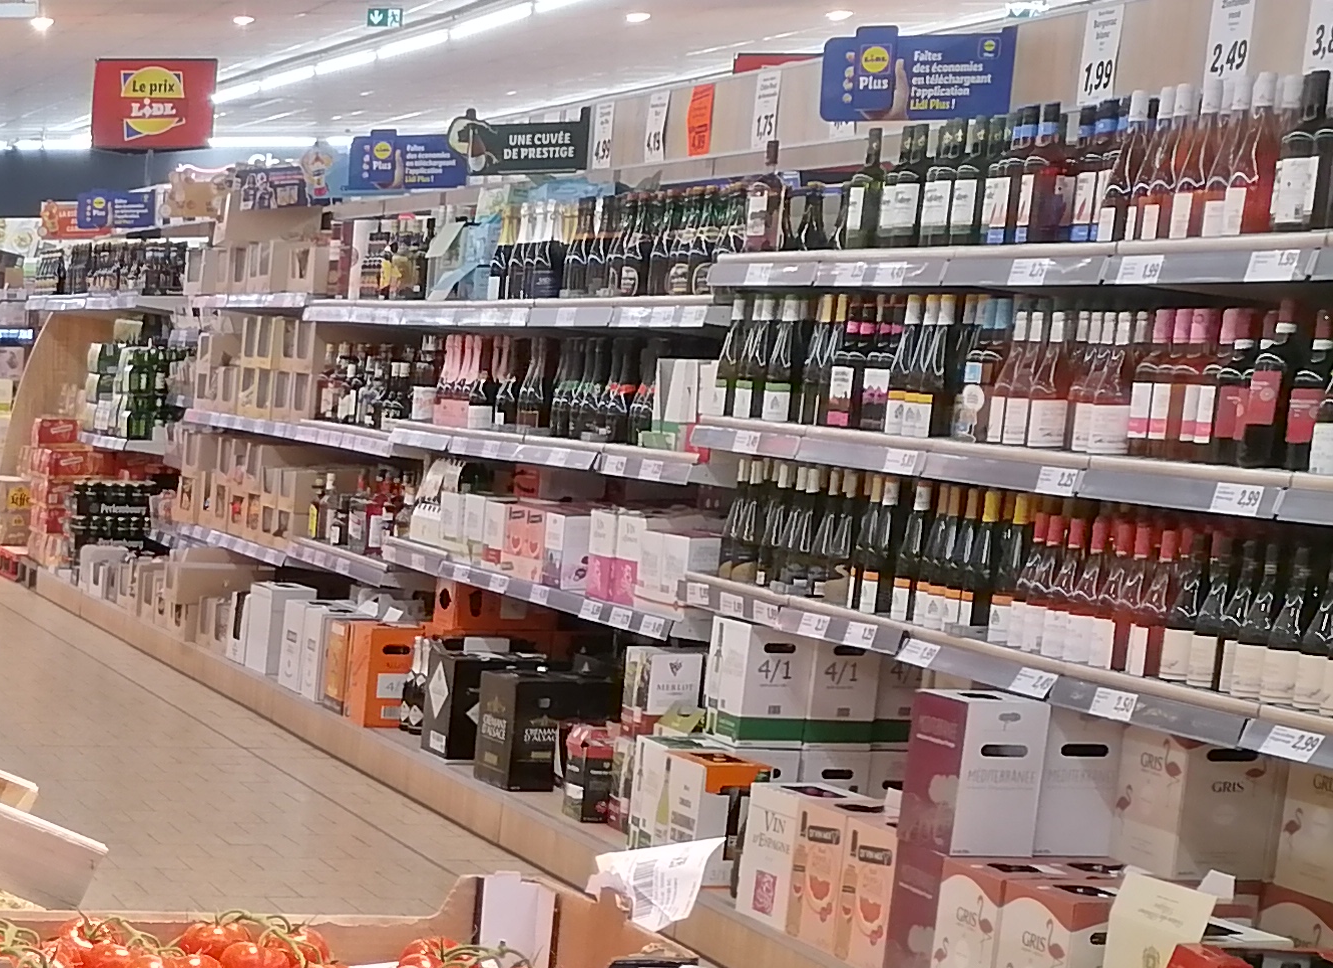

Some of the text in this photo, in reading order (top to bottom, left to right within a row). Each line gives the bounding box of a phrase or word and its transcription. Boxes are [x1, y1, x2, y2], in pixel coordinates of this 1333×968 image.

[914, 50, 942, 62] Faites
[1210, 39, 1247, 76] 2,49
[912, 60, 983, 74] des économies
[859, 76, 889, 90] Plus
[911, 73, 992, 87] en téléchargeant
[1084, 59, 1113, 96] 1,99
[132, 80, 175, 96] Le prix
[910, 99, 928, 110] Lidl
[931, 98, 950, 110] Plus
[508, 132, 571, 146] UNE CUVÉE
[503, 146, 575, 160] DE PRESTIGE
[372, 160, 392, 171] Plus
[1237, 489, 1261, 508] 2,99
[757, 660, 792, 681] 4/1
[824, 663, 858, 685] 4/1
[656, 683, 694, 692] MERLOT
[1291, 733, 1320, 752] 2,99
[1140, 751, 1164, 771] GRIS
[1211, 780, 1245, 793] GRIS
[955, 906, 979, 928] GRIS
[1021, 930, 1047, 953] GRIS
